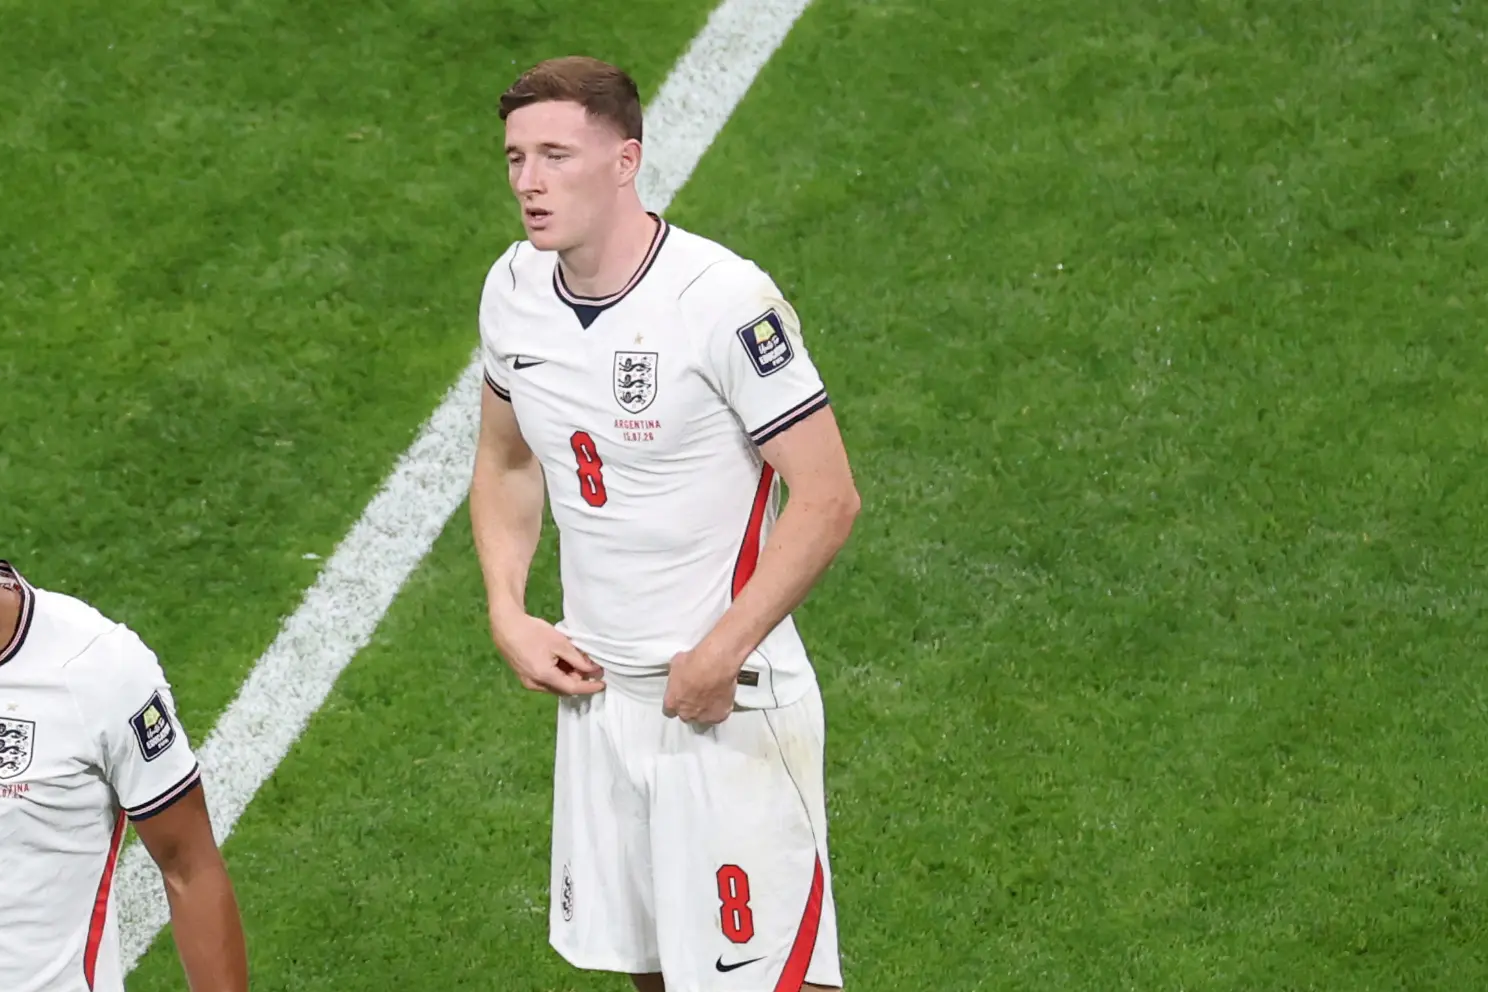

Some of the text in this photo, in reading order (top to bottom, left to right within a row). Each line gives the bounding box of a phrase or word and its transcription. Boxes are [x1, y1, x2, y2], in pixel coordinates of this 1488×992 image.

[614, 419, 661, 430] ARGENTINA
[570, 430, 608, 508] 8
[716, 864, 755, 944] 8
